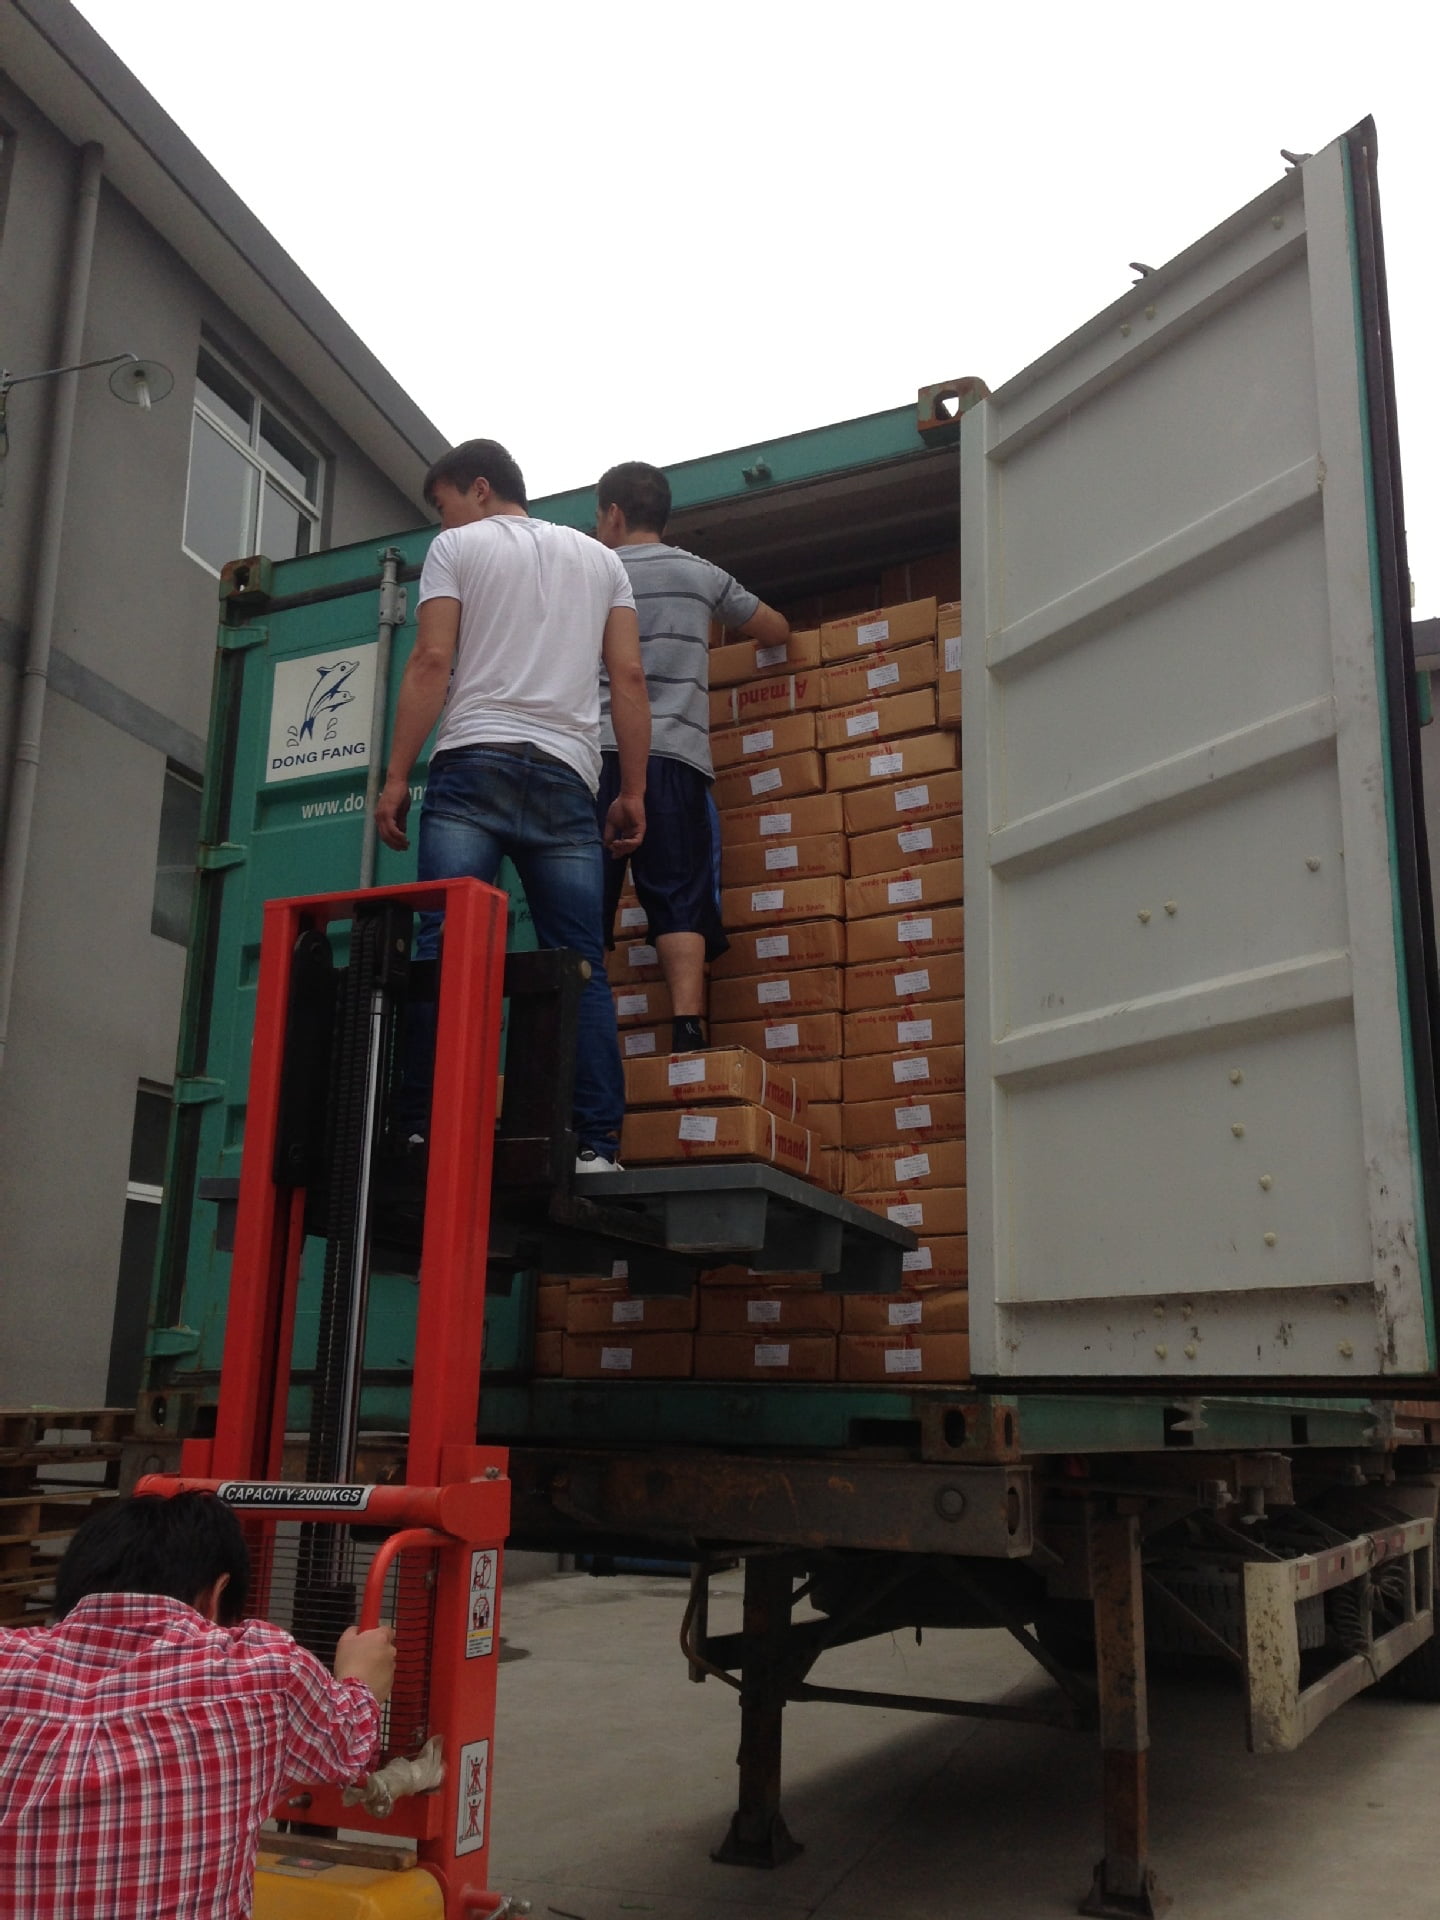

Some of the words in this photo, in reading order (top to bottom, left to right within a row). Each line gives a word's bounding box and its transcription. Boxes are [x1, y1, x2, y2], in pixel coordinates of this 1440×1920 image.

[728, 679, 807, 712] Amand
[272, 752, 317, 769] DONG
[321, 743, 365, 760] FANG
[759, 1081, 802, 1114] rmano
[226, 1487, 361, 1503] CAPACITY:2000KGS
